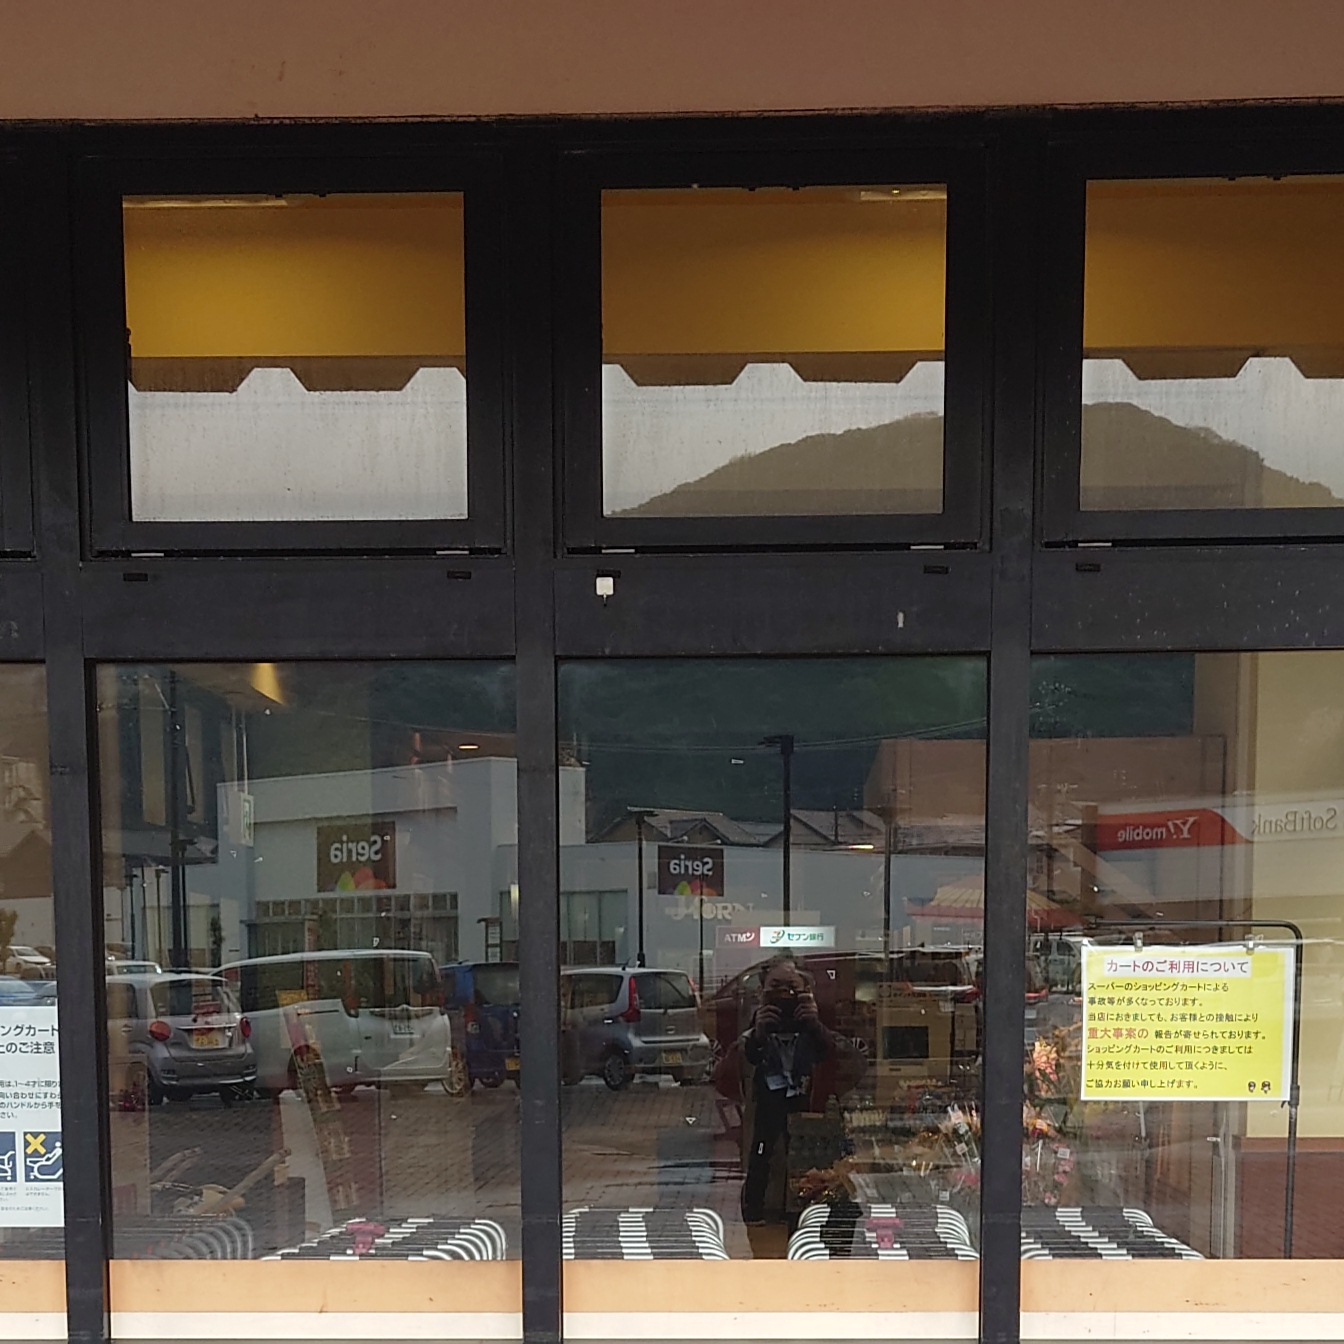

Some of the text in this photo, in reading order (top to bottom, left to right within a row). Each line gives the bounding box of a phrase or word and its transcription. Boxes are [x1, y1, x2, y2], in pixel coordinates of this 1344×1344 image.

[724, 932, 747, 942] ATM
[787, 932, 825, 941] セブン銀行
[1106, 959, 1250, 974] カートのご利用について
[1088, 981, 1230, 992] スーパーのショッピングカートによる
[1088, 996, 1204, 1007] 事故等が多くなっております。
[1088, 1012, 1259, 1023] 当店におきましても、お客様との接触により
[1088, 1027, 1267, 1040] 重大事案の 報告が寄せられております。
[1087, 1044, 1254, 1055] ショッピングカートのご利用につきましては
[1087, 1060, 1228, 1071] 十分気を付けて使用して頂くように、
[1086, 1079, 1199, 1089] ご協力お願い申し上げます。
